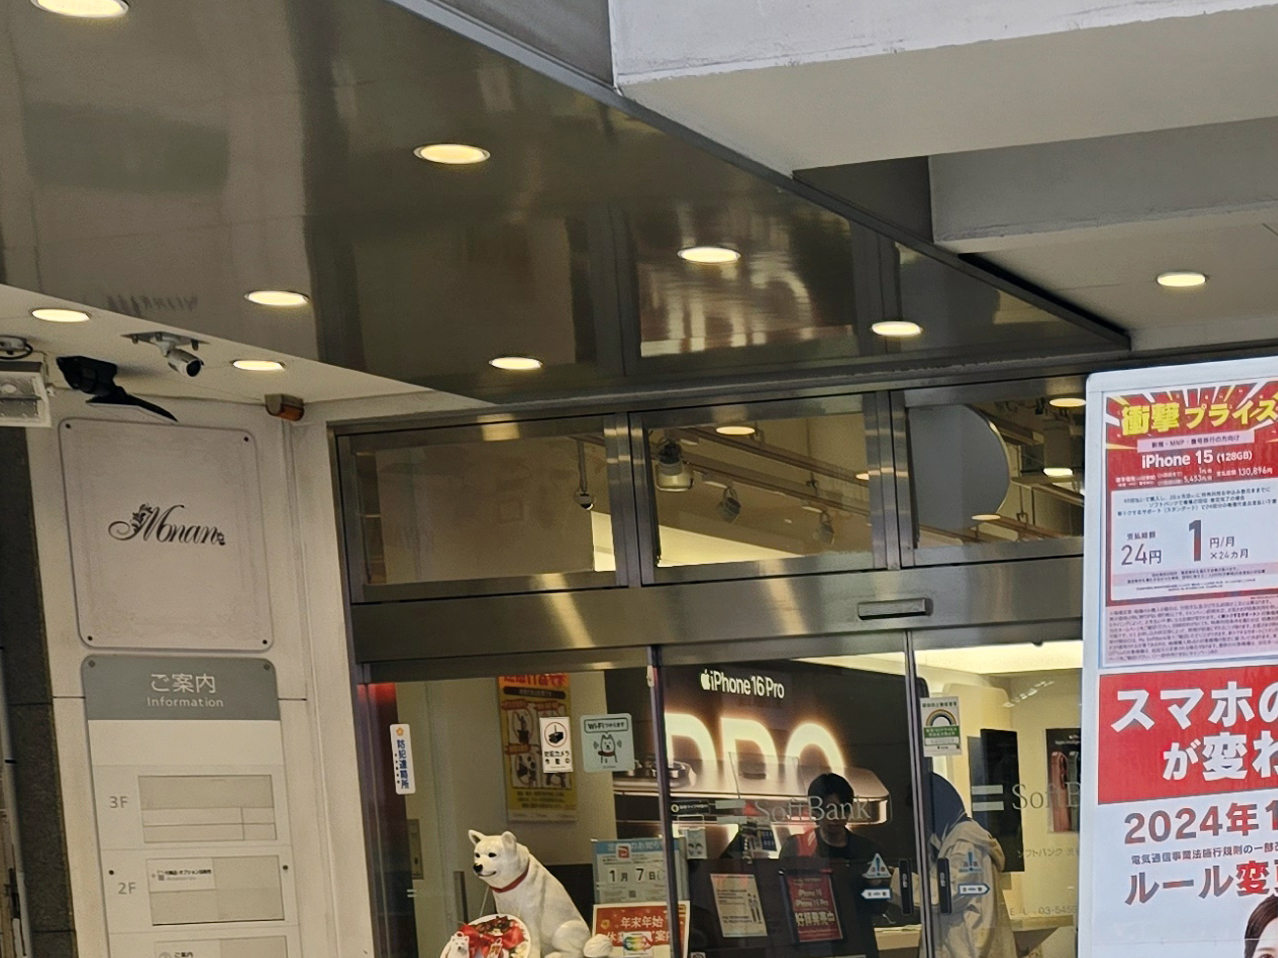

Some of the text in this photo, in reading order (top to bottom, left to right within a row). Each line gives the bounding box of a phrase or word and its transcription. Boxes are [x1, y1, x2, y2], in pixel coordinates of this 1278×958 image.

[1142, 450, 1253, 469] iPhone 15 (128GB)
[1188, 519, 1202, 562] 1
[1209, 536, 1235, 549] 円/月
[1121, 543, 1162, 566] 24円
[150, 673, 216, 694] ご案内
[710, 671, 785, 699] iPhone 16 Pro
[147, 697, 224, 708] Information
[109, 796, 128, 809] 3F
[754, 795, 872, 823] SoftBank
[118, 881, 137, 895] 2F
[620, 916, 664, 929] 年末年始
